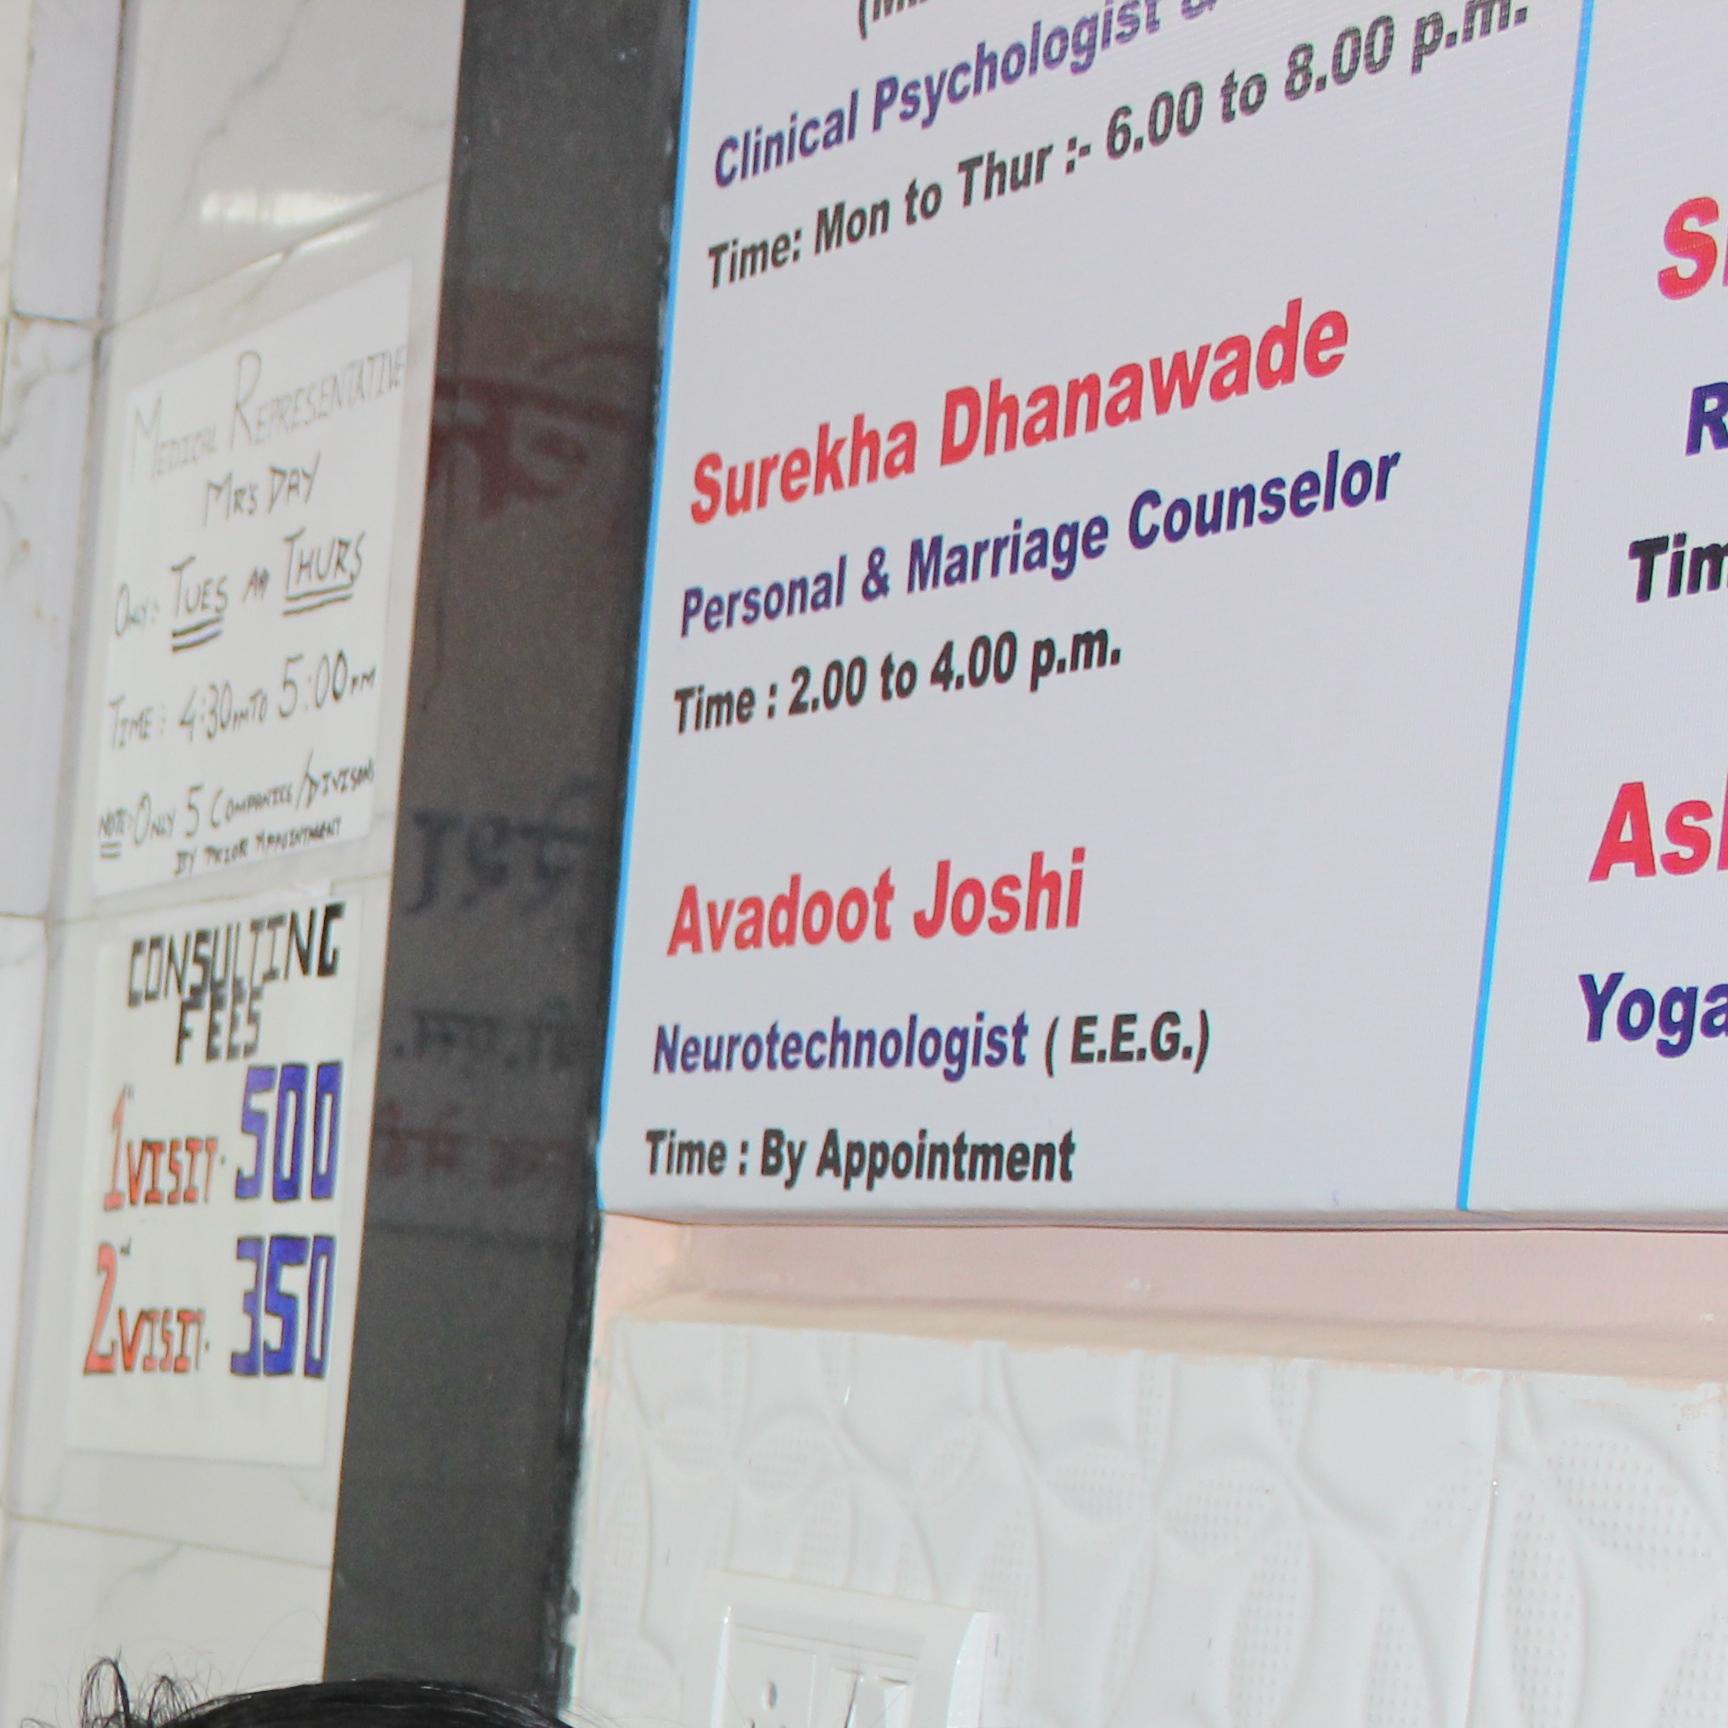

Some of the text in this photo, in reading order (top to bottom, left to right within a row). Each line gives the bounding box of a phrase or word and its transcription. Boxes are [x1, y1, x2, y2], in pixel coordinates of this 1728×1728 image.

[708, 229, 802, 290] Time:
[814, 201, 889, 256] Mon
[903, 180, 942, 227] to
[957, 143, 1055, 208] Thur
[1106, 81, 1204, 158] 6.00
[1221, 68, 1268, 123] to
[1284, 21, 1394, 102] 8.00
[1411, 0, 1528, 73] p.m.
[714, 0, 1160, 188] Clinical Psychologist
[1657, 196, 1728, 301] S
[690, 416, 917, 526] Surekha
[942, 298, 1349, 467] Dhanawade
[170, 556, 229, 620] TUES
[283, 527, 365, 592] THURS
[681, 446, 1401, 639] Personal & Marriage Counselor
[674, 680, 756, 736] Time
[789, 655, 867, 715] 2.00
[880, 649, 916, 700] to
[930, 632, 1018, 690] 4.00
[1031, 627, 1123, 694] p.m.
[186, 784, 204, 839] 5
[1588, 762, 1728, 882] As
[127, 901, 346, 1008] CONSULTING
[667, 846, 1087, 957] Avadoot Joshi
[175, 984, 264, 1065] FEES
[653, 1011, 1028, 1082] Neurotechnologist
[234, 1061, 343, 1202] 500
[644, 1130, 727, 1177] Time
[760, 1127, 805, 1190] By
[816, 1128, 1076, 1191] Appointment
[230, 1234, 336, 1379] 350
